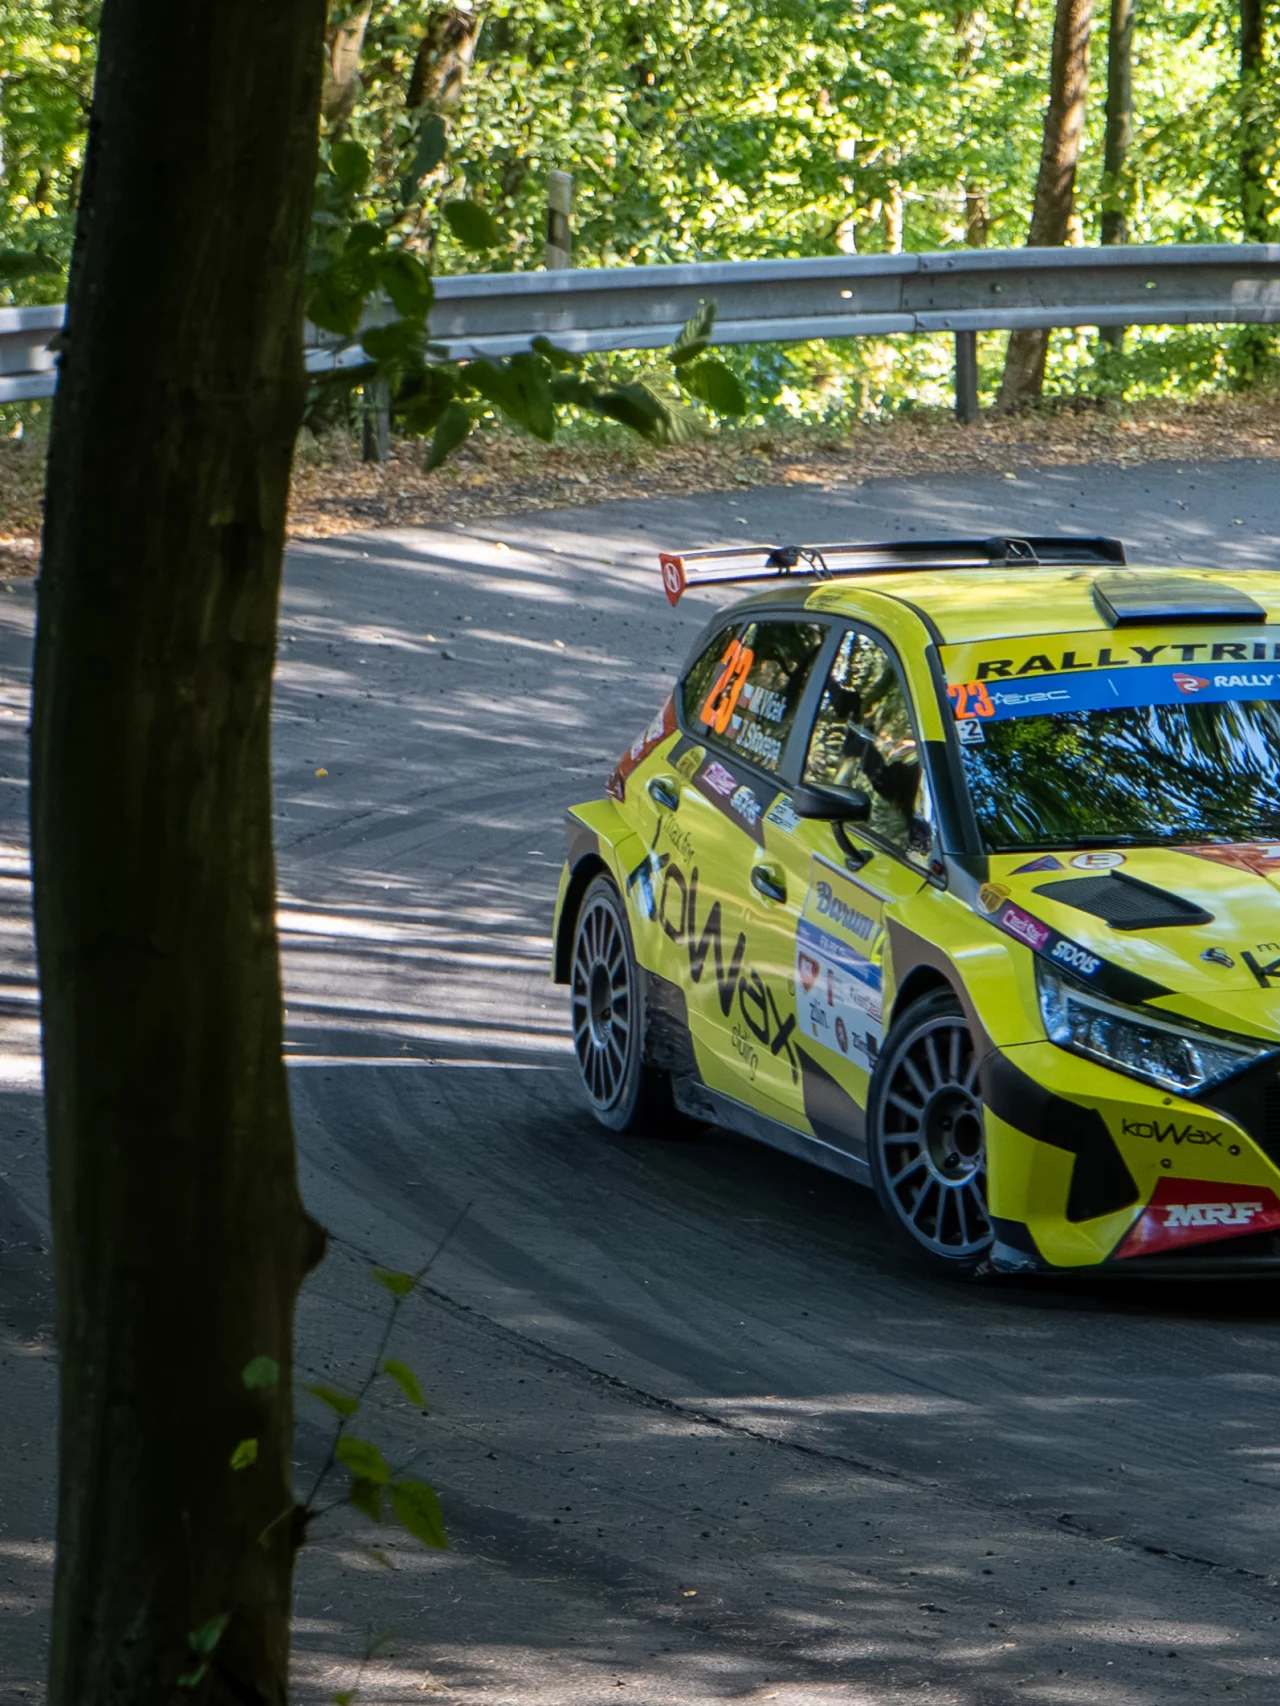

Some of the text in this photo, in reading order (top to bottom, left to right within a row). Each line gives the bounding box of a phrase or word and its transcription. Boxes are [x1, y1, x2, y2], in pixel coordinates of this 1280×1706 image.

[701, 639, 755, 734] 23
[1213, 674, 1275, 688] RALLY
[947, 681, 996, 720] 23
[1086, 854, 1110, 866] E
[1163, 1202, 1263, 1227] MRF
